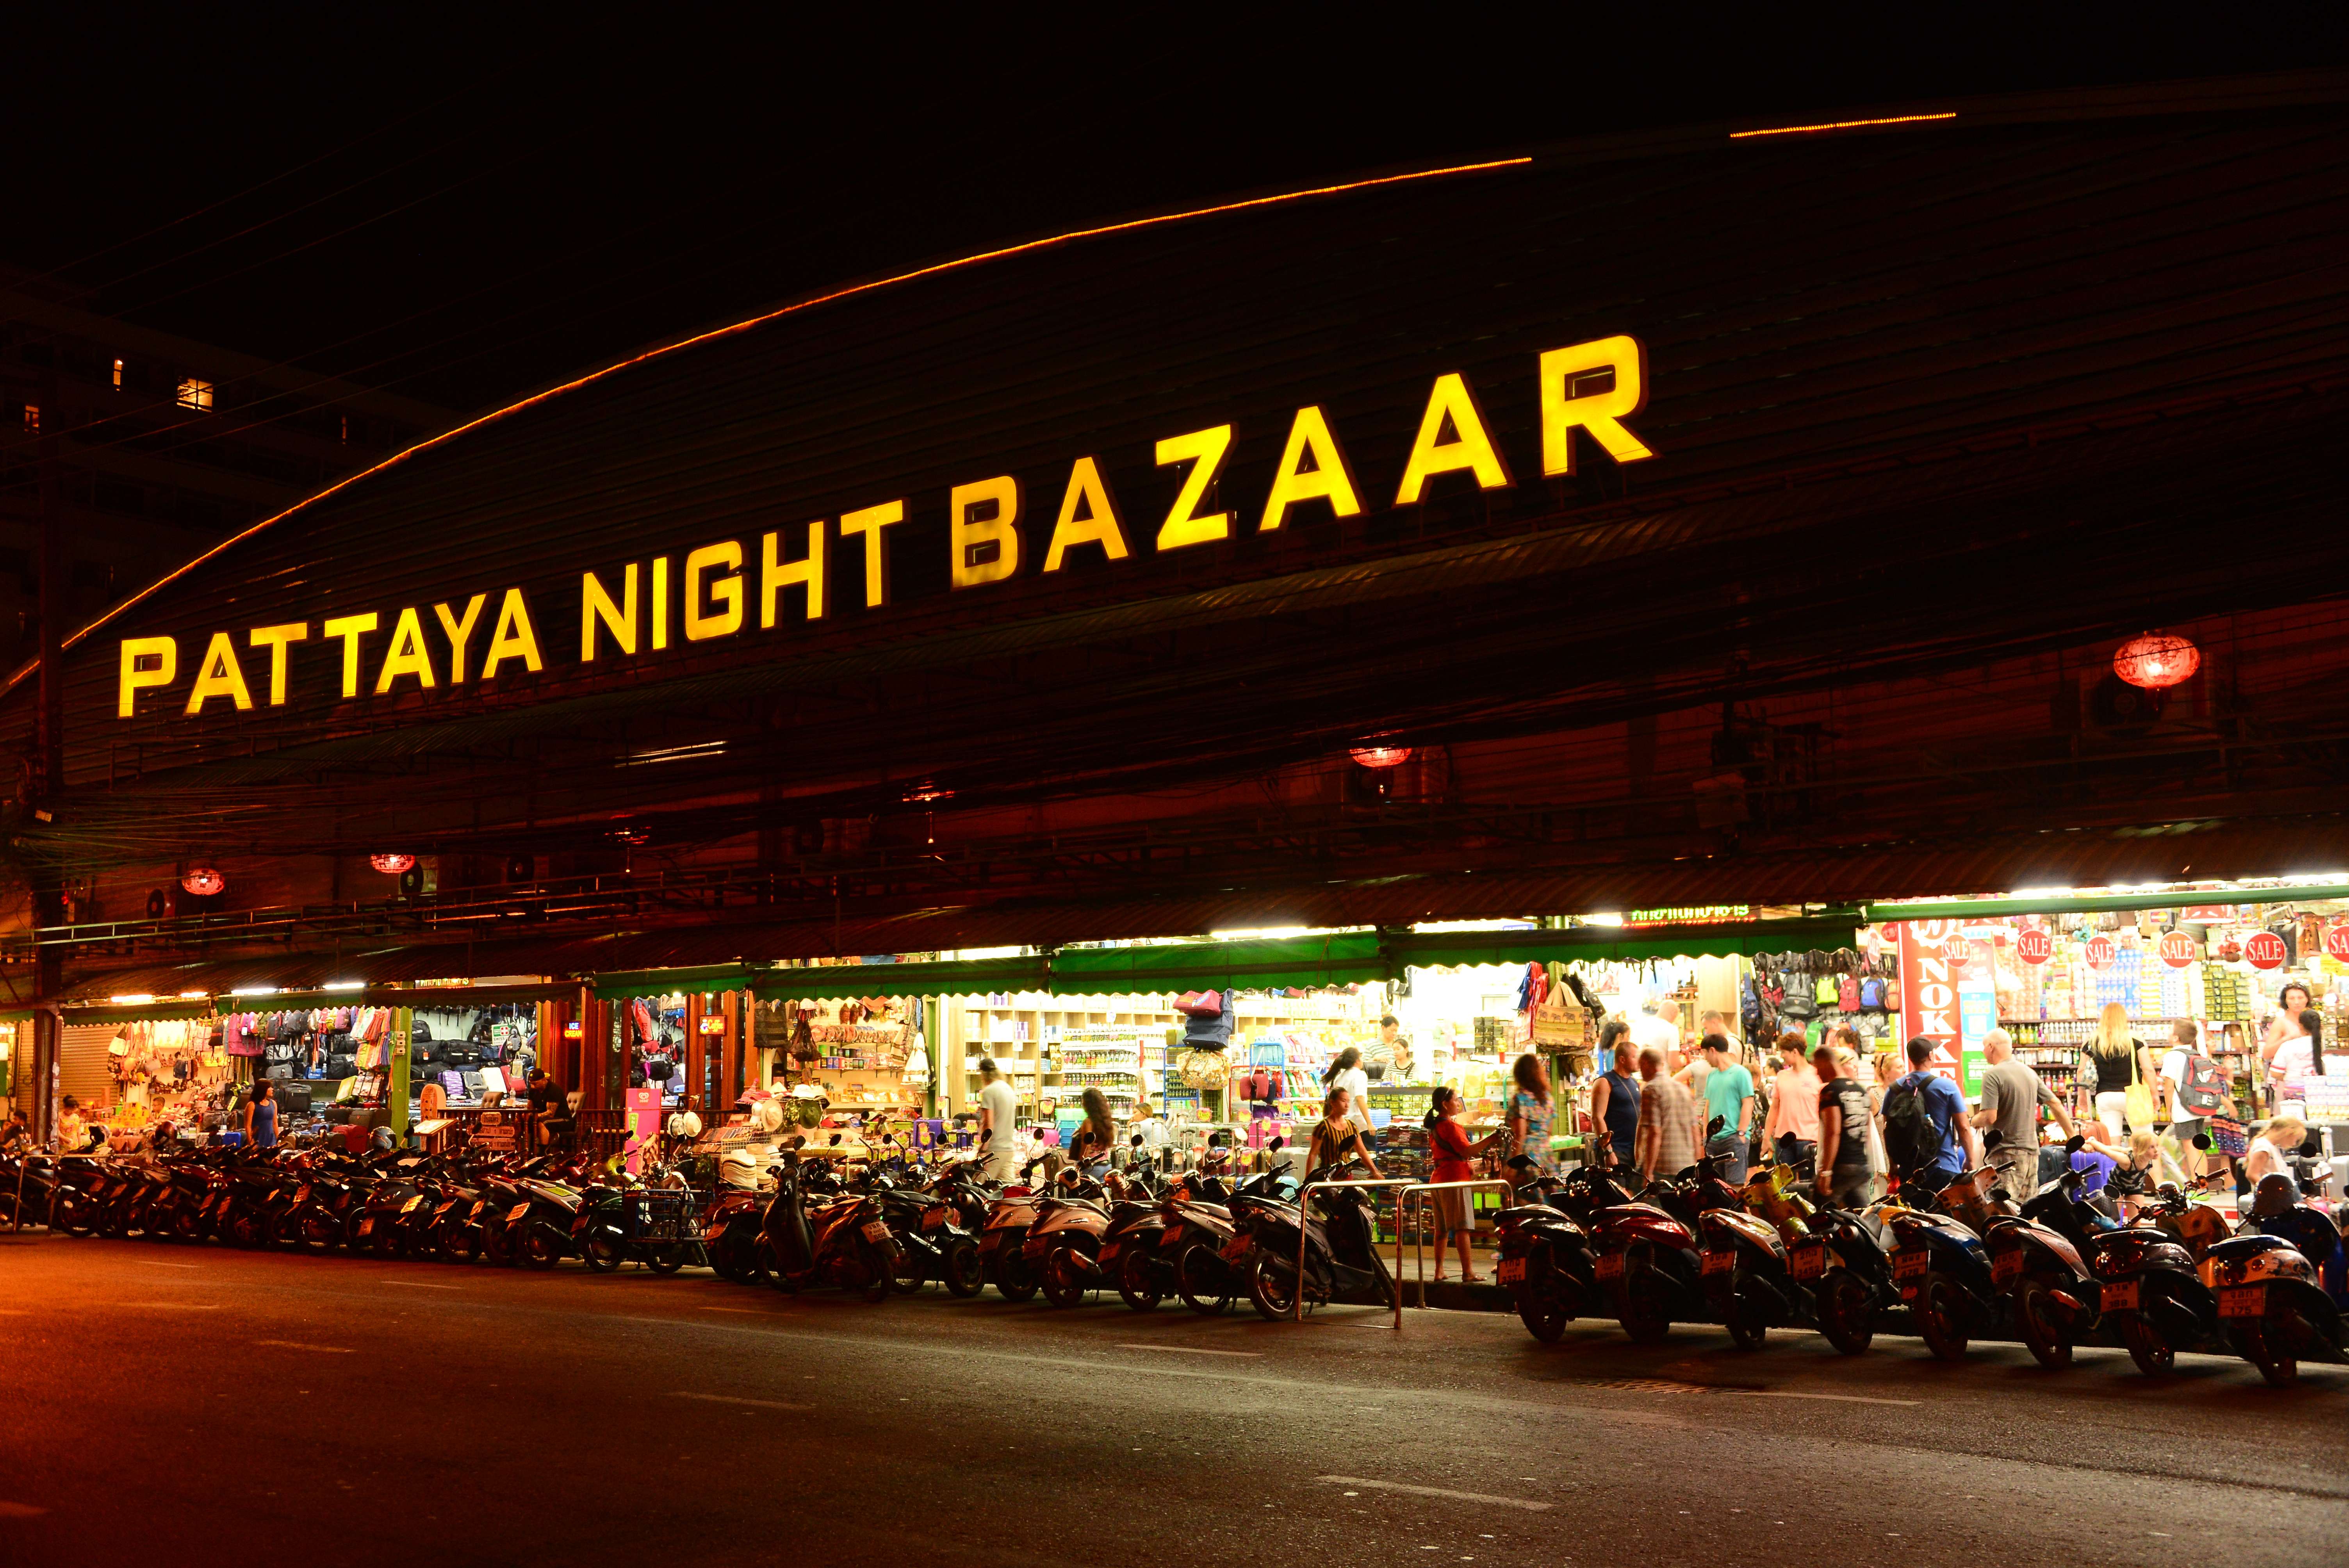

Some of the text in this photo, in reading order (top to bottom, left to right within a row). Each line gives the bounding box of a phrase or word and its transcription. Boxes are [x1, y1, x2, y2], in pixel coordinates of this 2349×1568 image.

[119, 335, 1653, 717] PATTAYA NIGHT BAZAAR
[1944, 941, 1969, 960] SALE
[2019, 937, 2048, 956] SALE
[2087, 944, 2113, 962] SALE
[2162, 940, 2193, 959] SALE
[2248, 941, 2282, 961] SALE
[2330, 934, 2349, 954] SA
[708, 1019, 724, 1032] Coffee
[2231, 1306, 2253, 1315] 175
